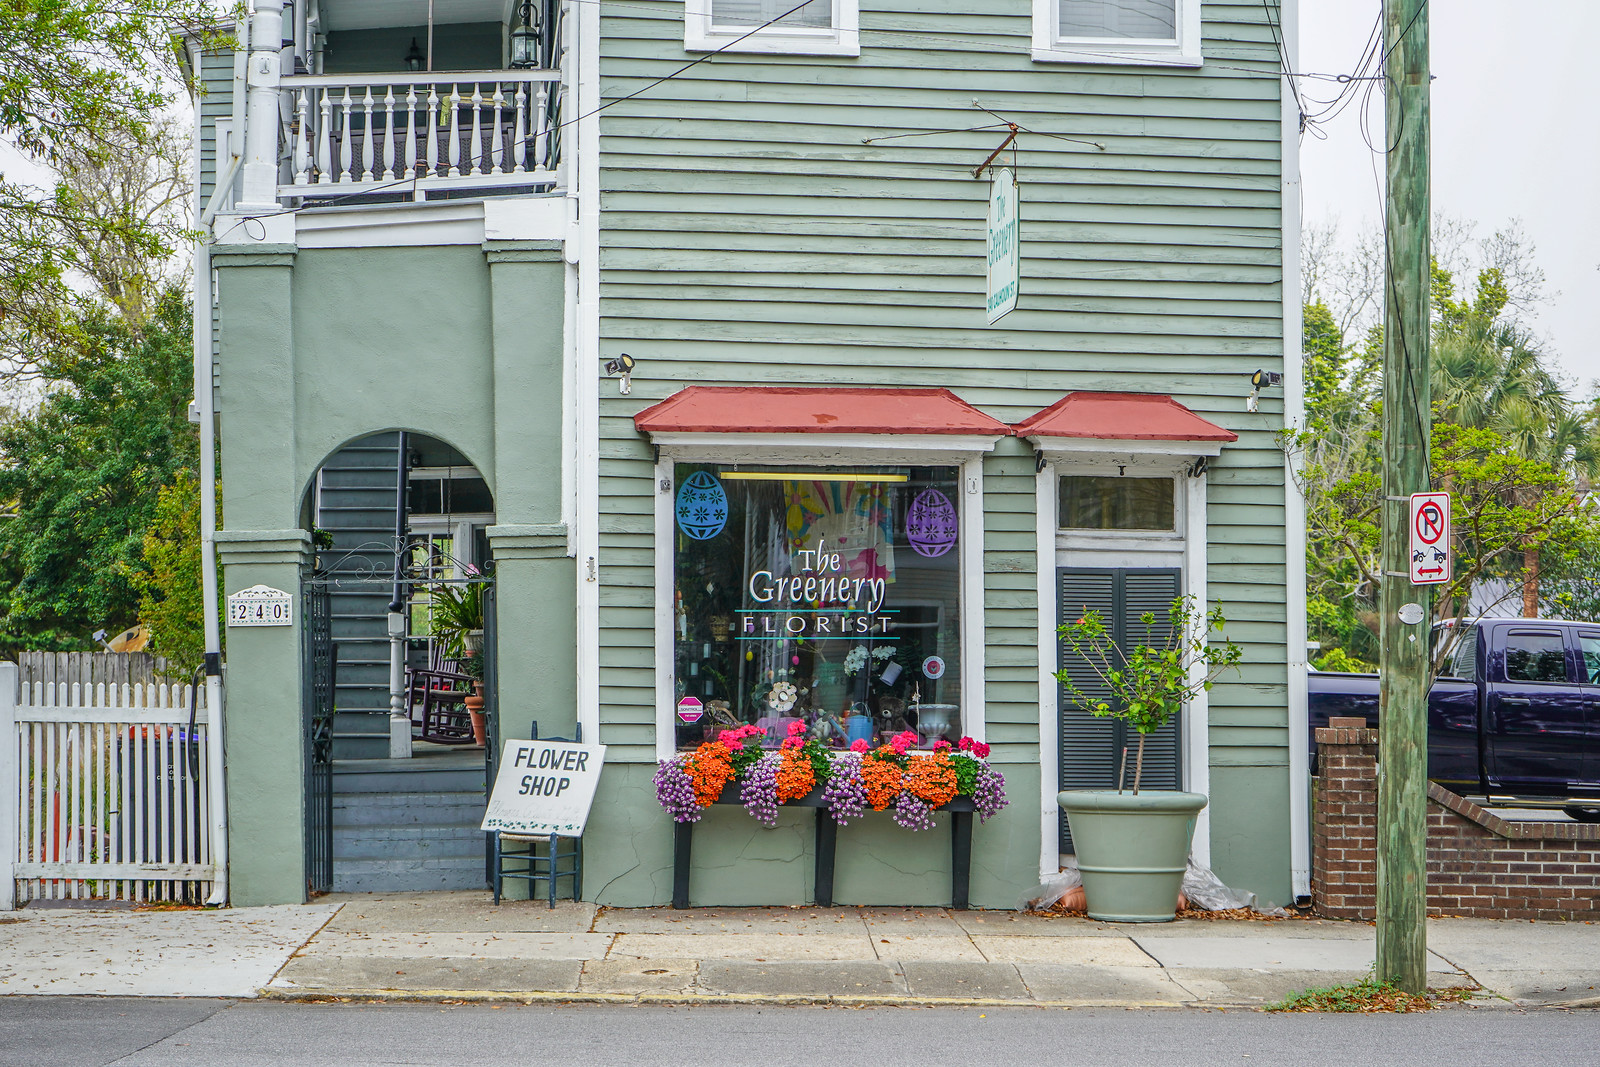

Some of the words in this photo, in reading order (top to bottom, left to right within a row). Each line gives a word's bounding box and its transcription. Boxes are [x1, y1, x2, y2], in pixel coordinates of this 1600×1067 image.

[988, 219, 1015, 267] Greenery
[798, 539, 841, 576] The
[749, 571, 886, 614] Greenery
[238, 604, 282, 619] 240
[743, 616, 892, 633] FLORIST
[514, 747, 589, 772] FLOWER
[518, 775, 570, 797] SHOP
